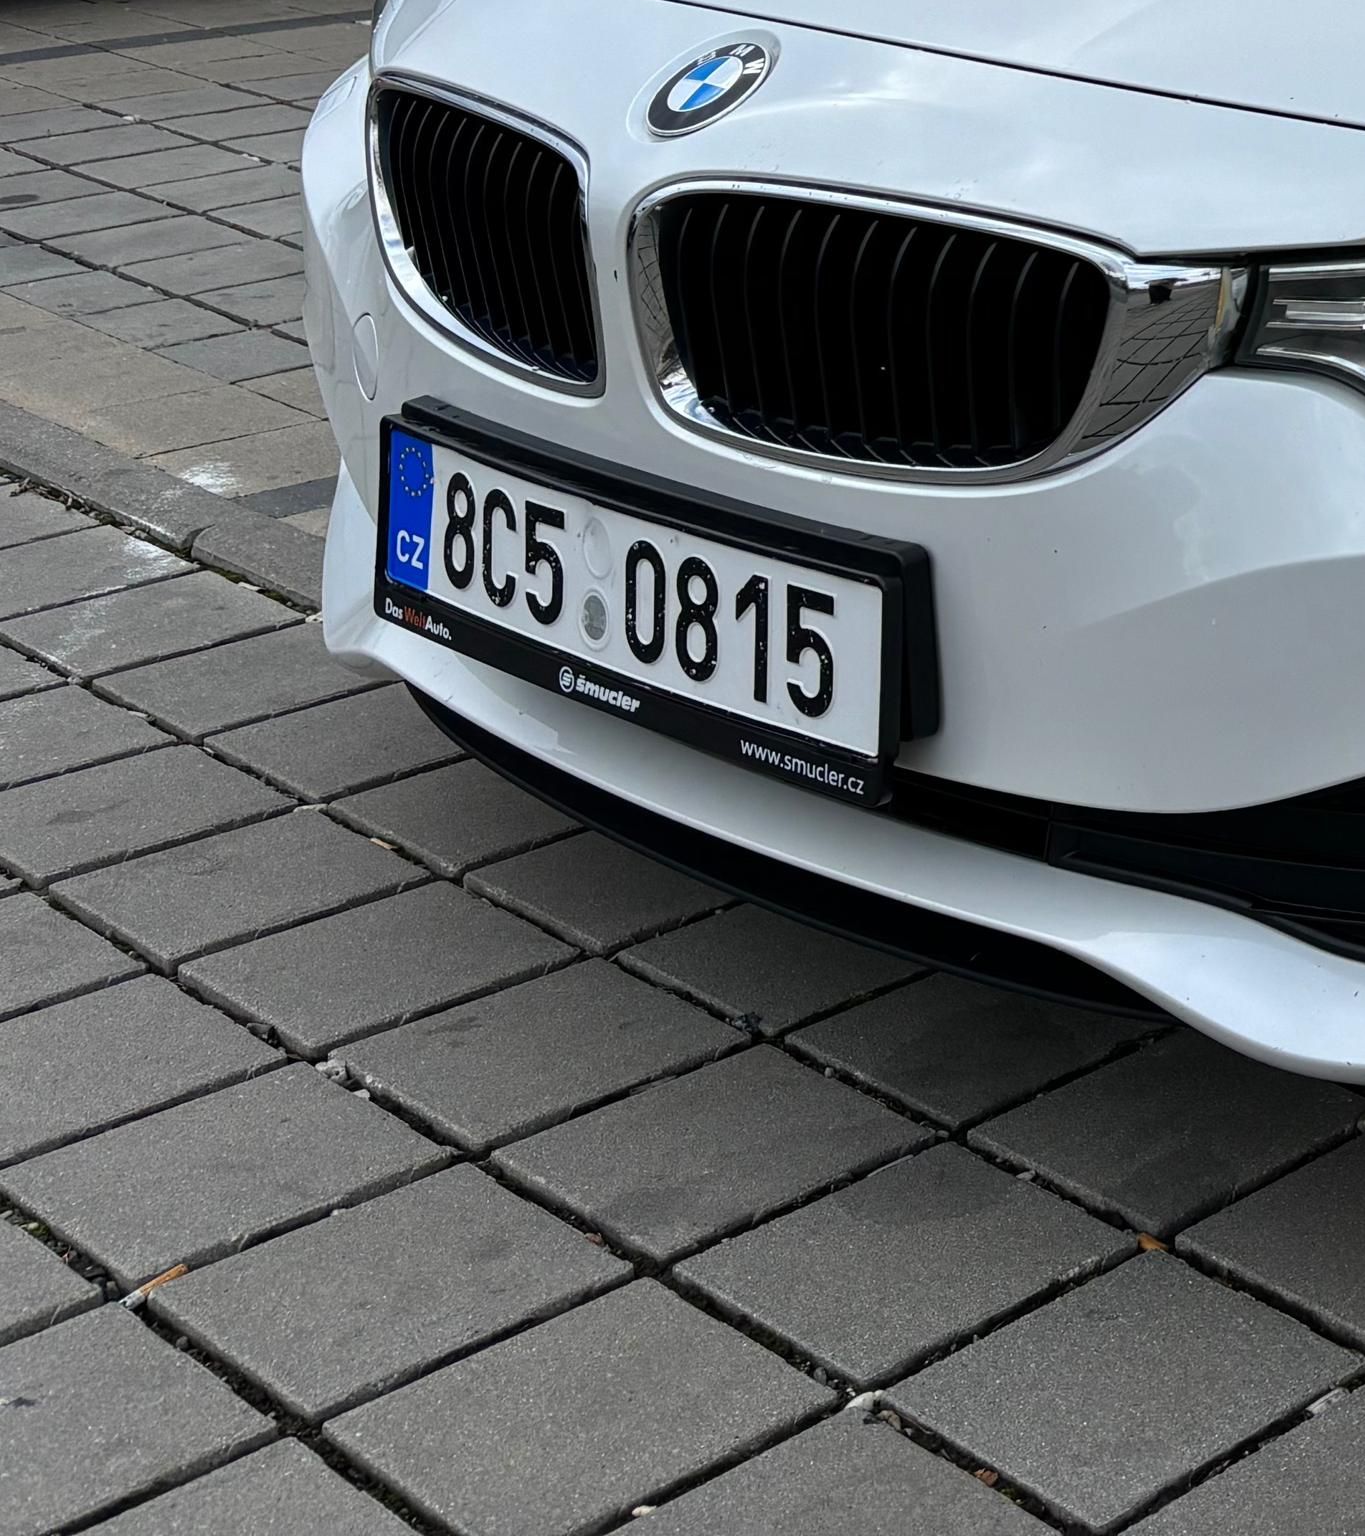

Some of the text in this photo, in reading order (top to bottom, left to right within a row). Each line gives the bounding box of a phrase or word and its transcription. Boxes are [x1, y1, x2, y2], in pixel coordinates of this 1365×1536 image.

[696, 44, 765, 75] BMW
[396, 529, 425, 570] CZ
[442, 471, 835, 719] 8C5 0815
[575, 674, 641, 713] šmucler
[740, 739, 864, 795] www.smucler.cz
